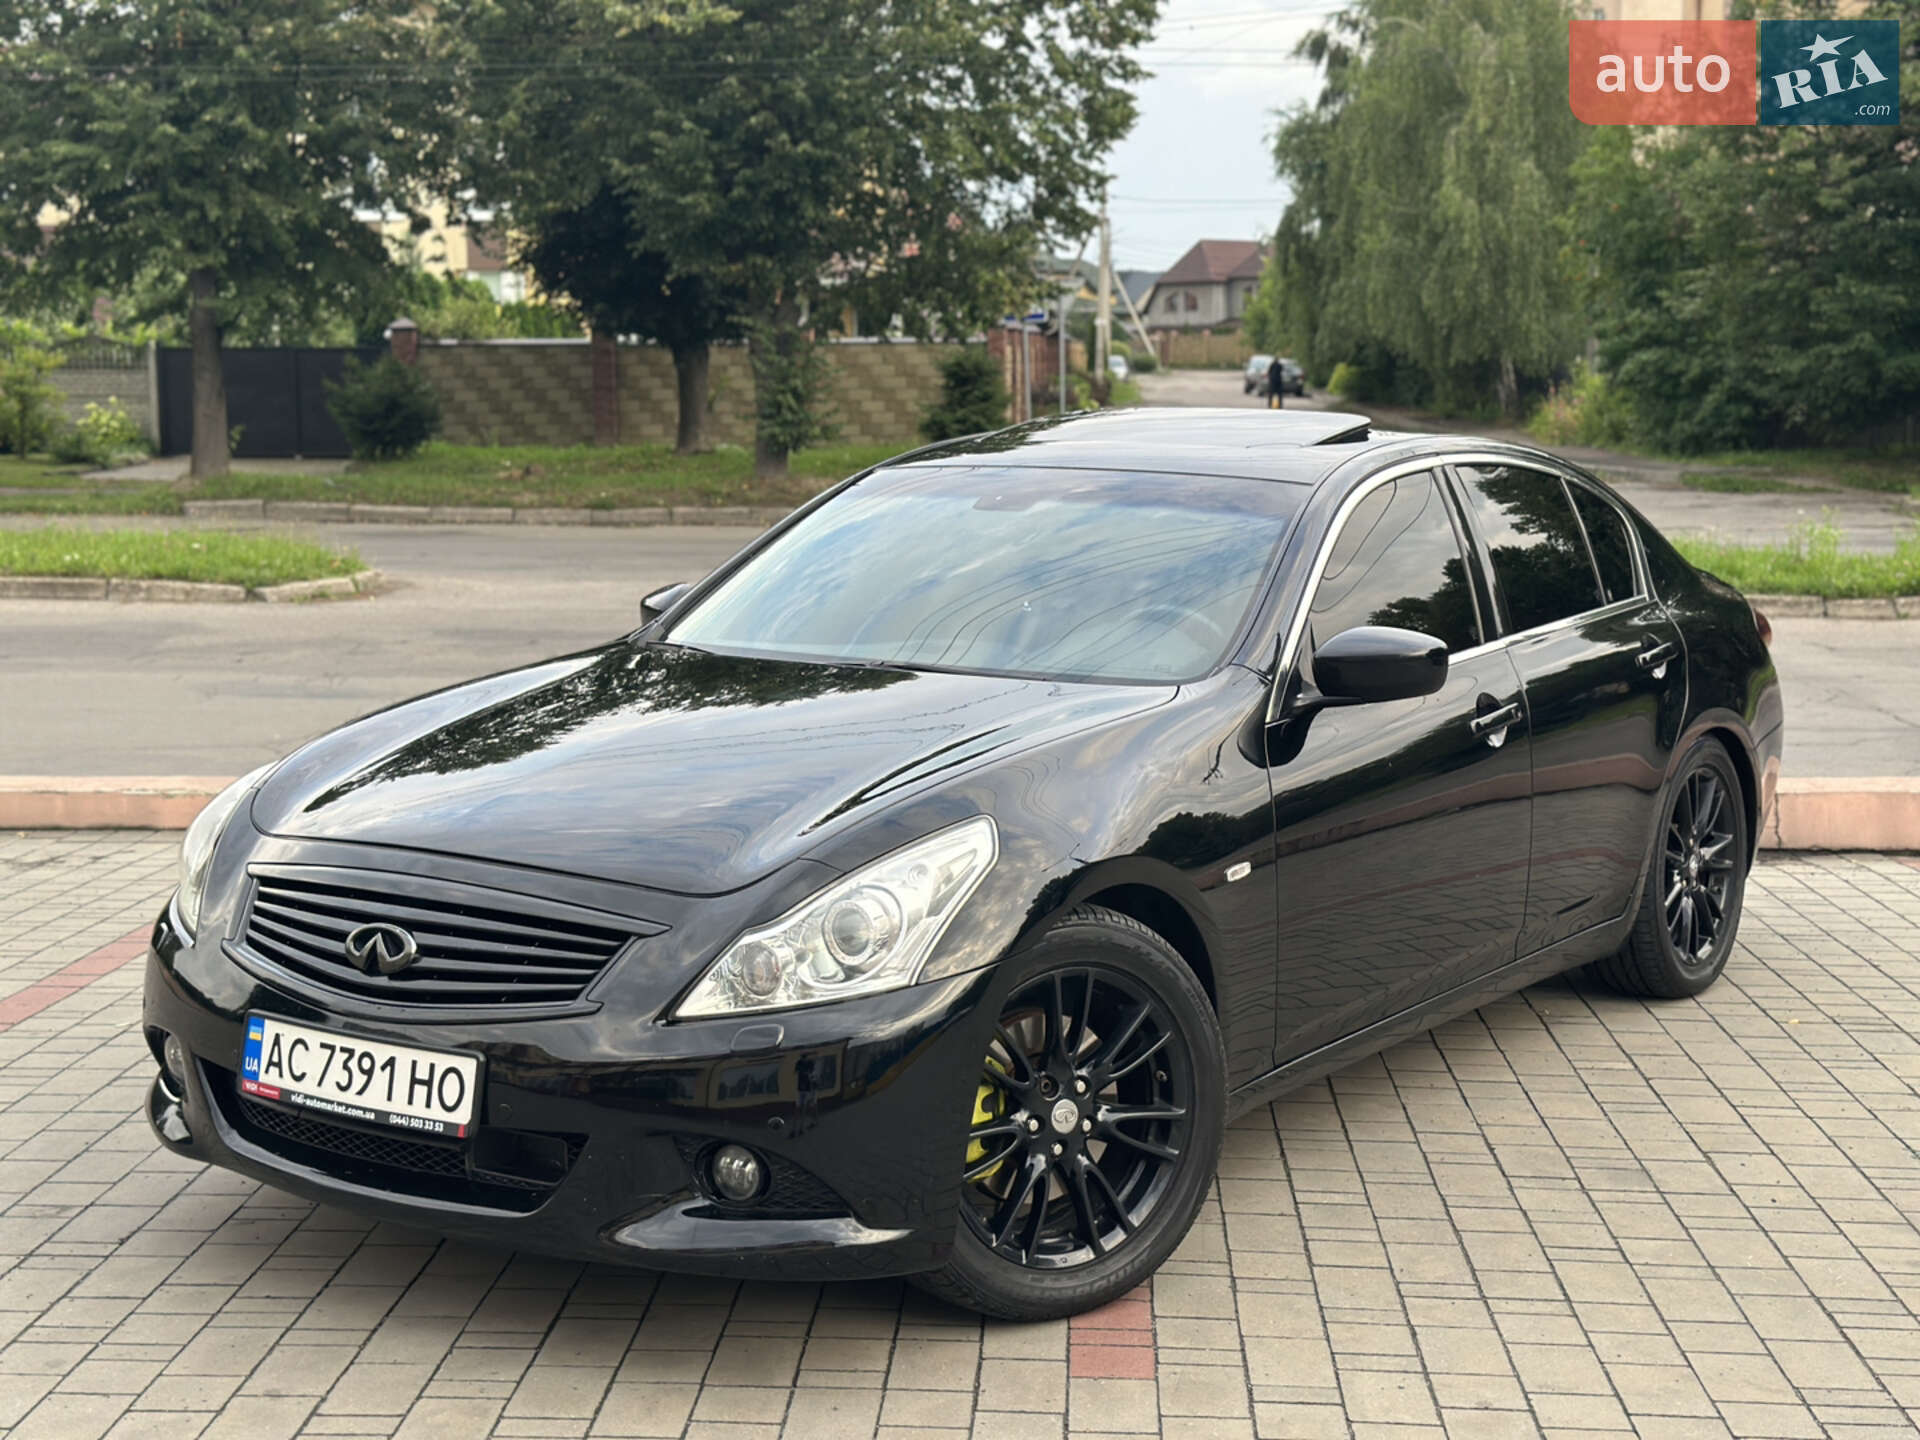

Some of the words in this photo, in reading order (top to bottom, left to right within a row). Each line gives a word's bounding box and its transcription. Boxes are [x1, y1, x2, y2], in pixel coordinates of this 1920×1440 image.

[245, 1056, 260, 1073] UA
[265, 1032, 309, 1082] AC
[317, 1042, 397, 1102] 7391
[407, 1059, 465, 1113] HO
[290, 1093, 375, 1120] vidi-automarket.com.ua
[389, 1113, 409, 1127] (044)
[410, 1117, 423, 1129] 503
[424, 1119, 433, 1130] 33
